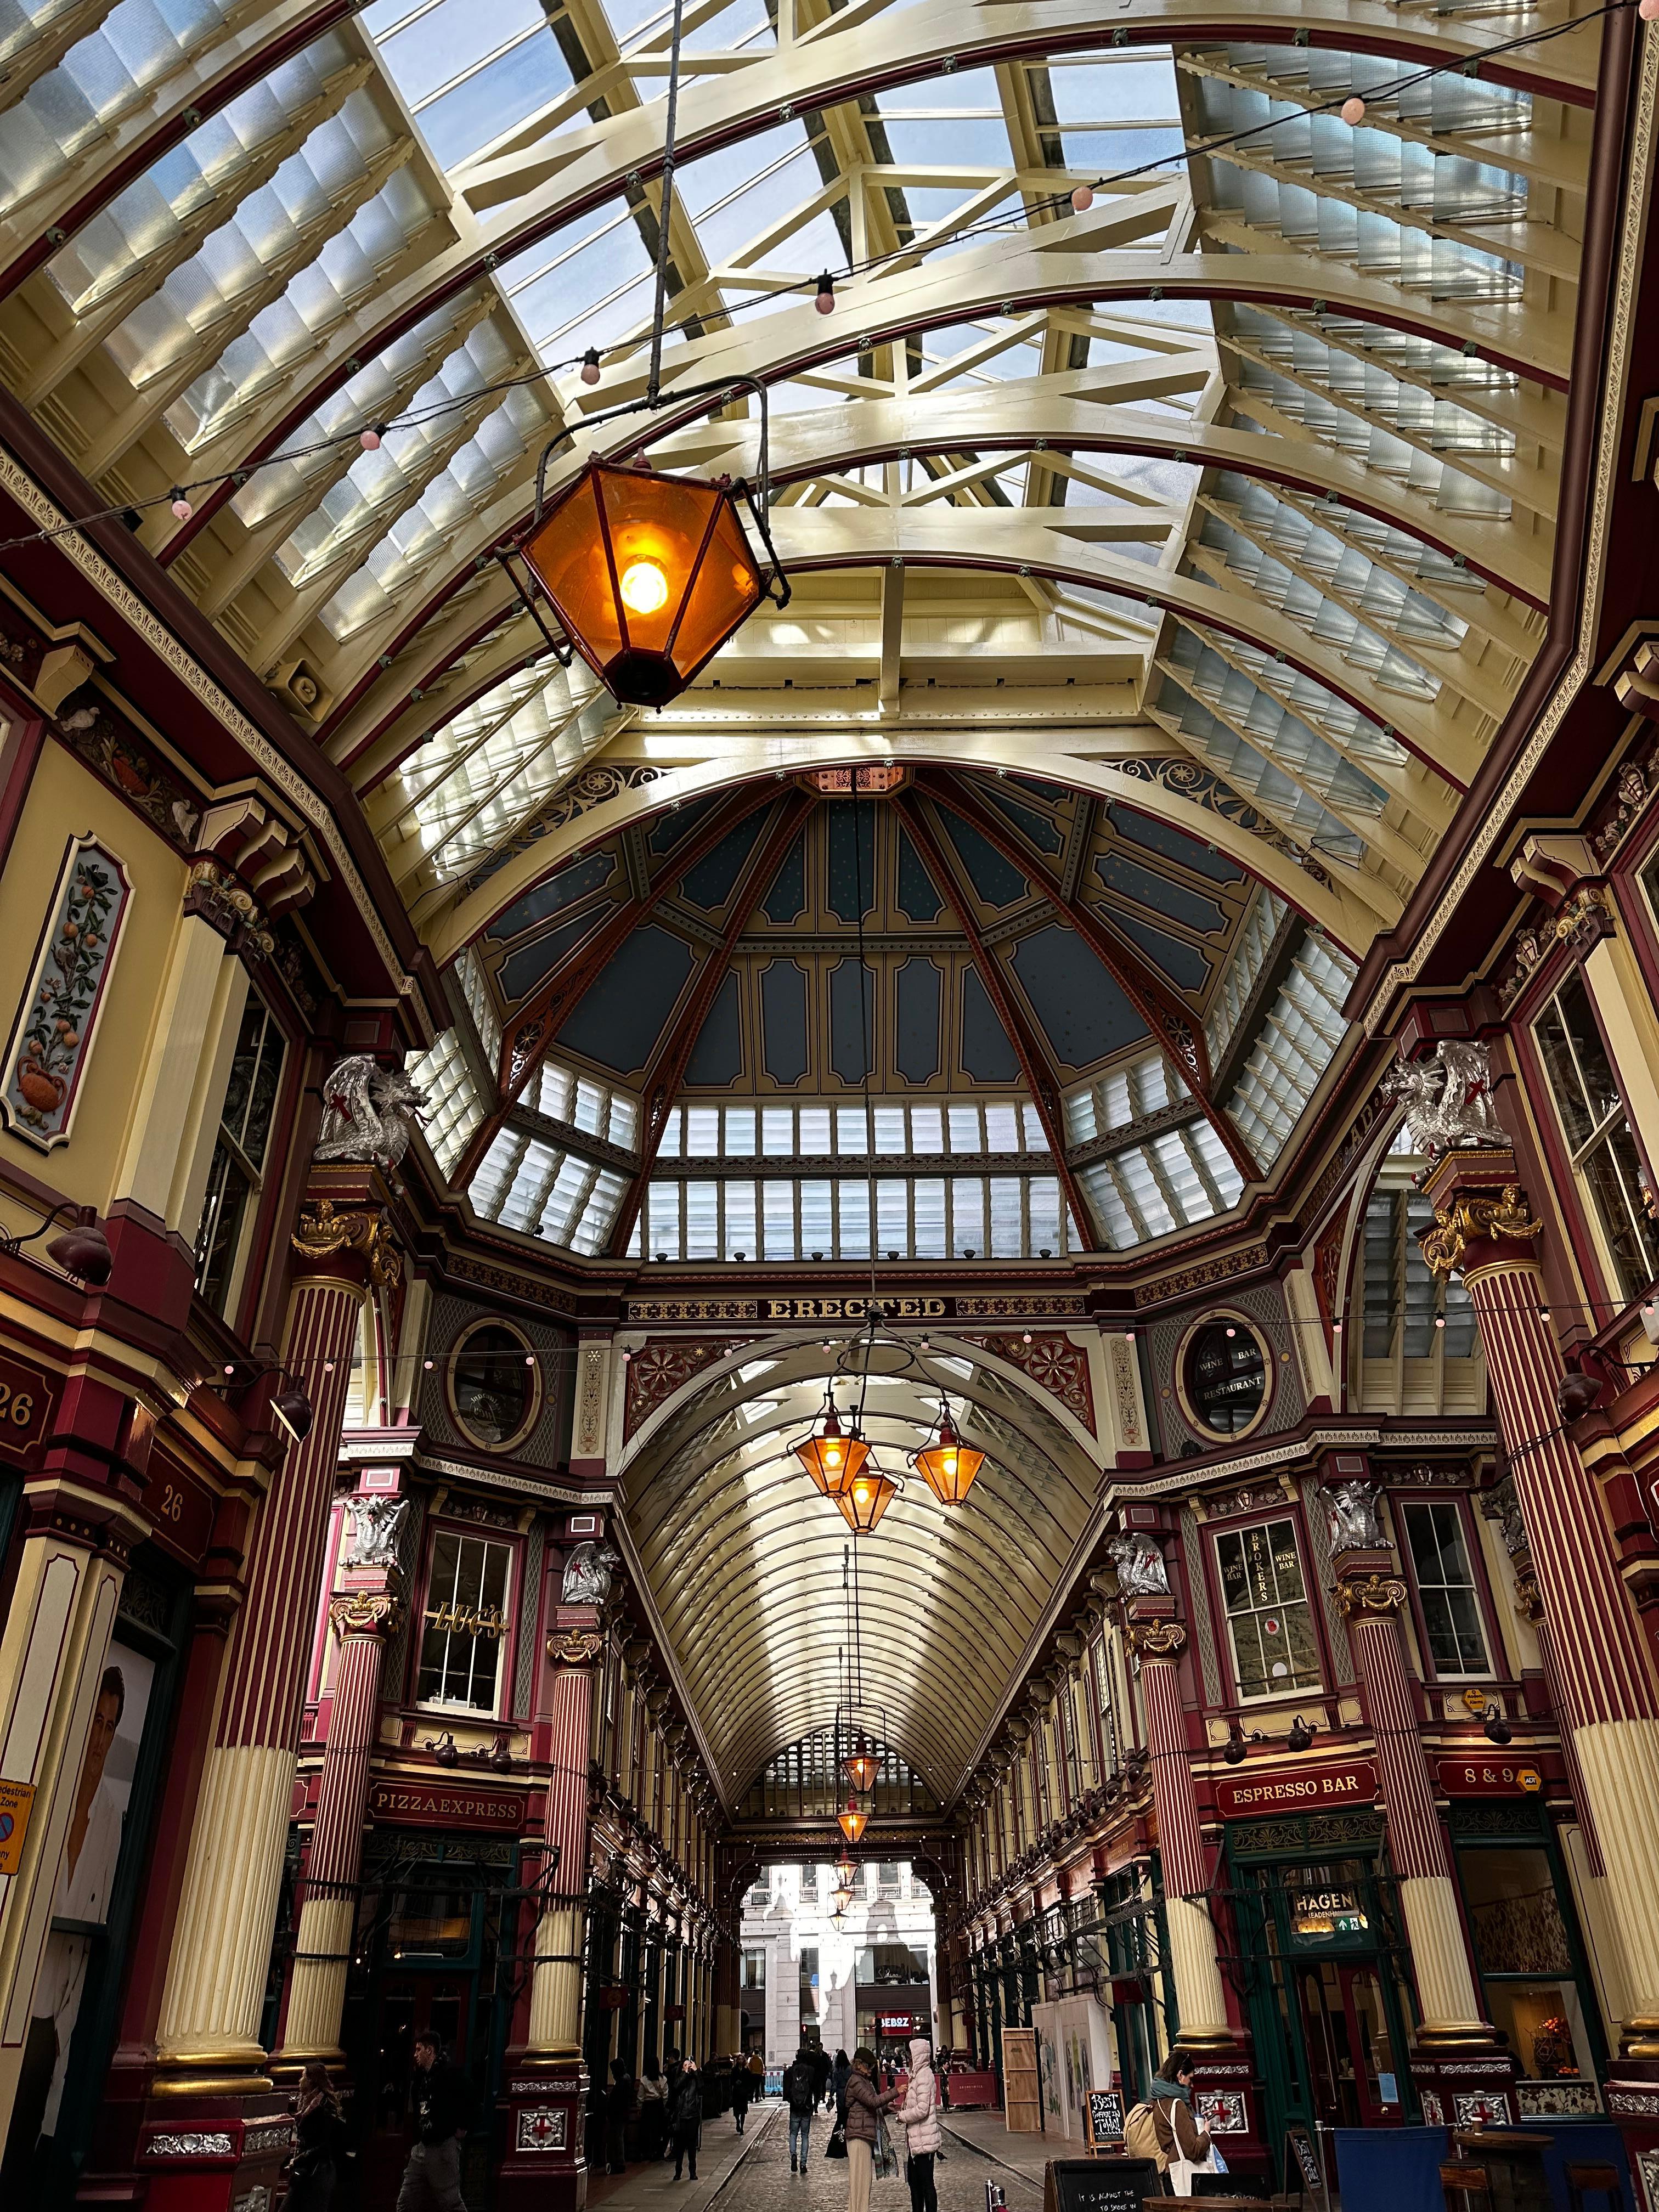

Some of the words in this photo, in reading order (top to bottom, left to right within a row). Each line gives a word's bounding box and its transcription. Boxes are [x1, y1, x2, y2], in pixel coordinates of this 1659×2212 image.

[768, 1298, 946, 1318] ERECTED
[1199, 1358, 1224, 1371] WINE
[1238, 1348, 1257, 1360] BAR
[1204, 1376, 1261, 1400] RESTAURANT
[161, 1484, 183, 1522] 26
[1275, 1551, 1297, 1562] WINE
[1278, 1560, 1295, 1571] BAR
[1223, 1563, 1244, 1574] WINE
[1227, 1572, 1243, 1582] BAR
[1251, 1532, 1268, 1602] BROKERS
[432, 1601, 504, 1639] LUC'S
[1464, 1768, 1476, 1783] 8
[1482, 1768, 1498, 1783] &
[1502, 1768, 1514, 1782] 9
[1232, 1780, 1317, 1804] ESPRESSO
[1321, 1775, 1359, 1793] BAR
[0, 1797, 18, 1808] Zone
[377, 1793, 517, 1819] PIZZAEXPRESS
[1296, 1893, 1353, 1911] HAGEN
